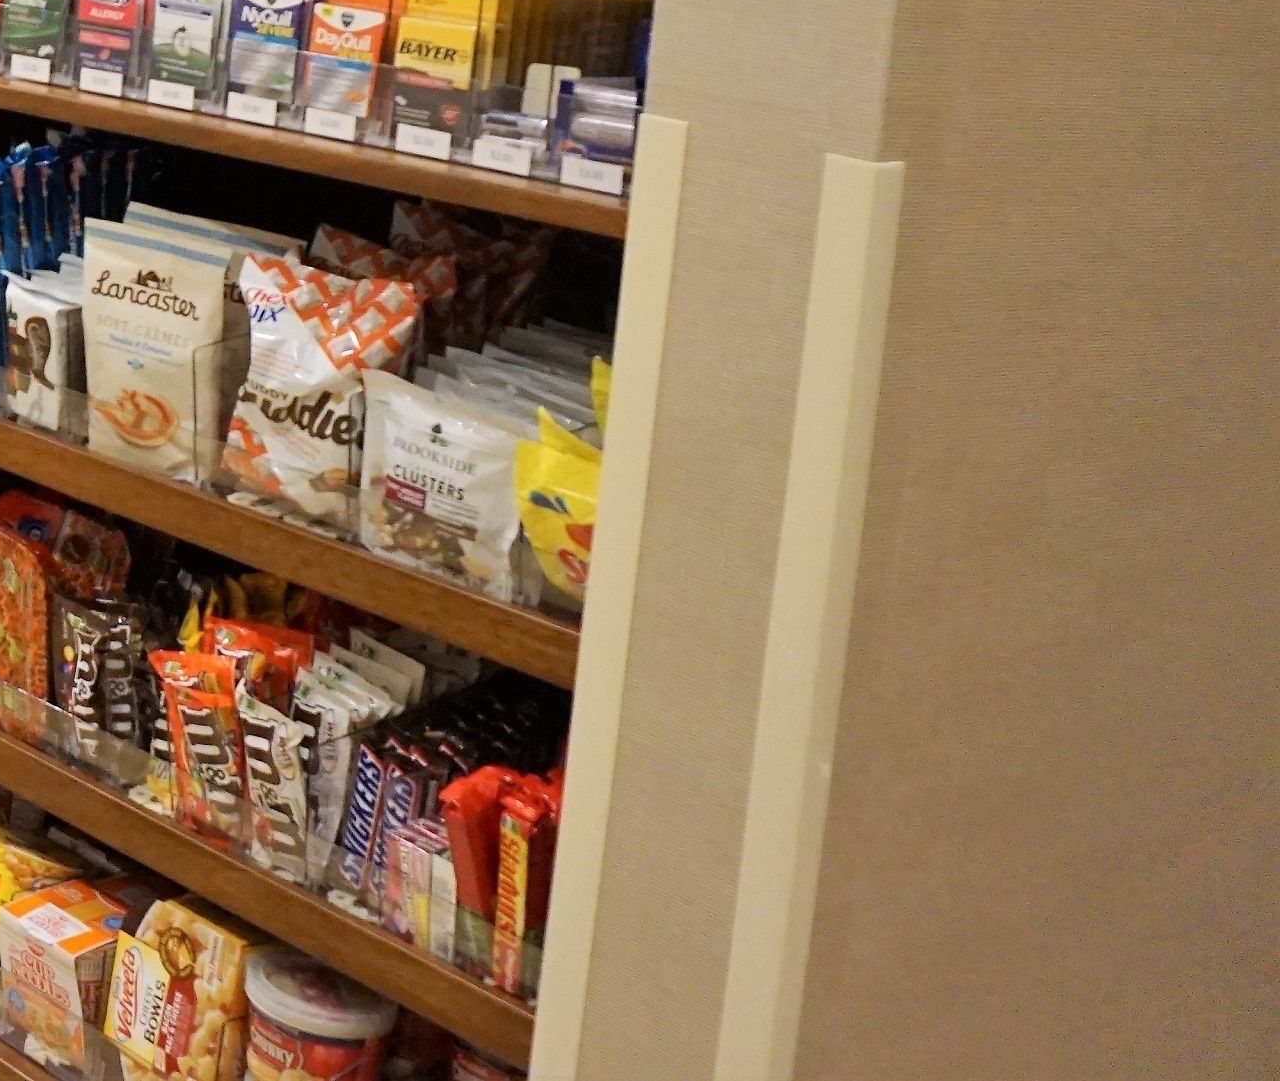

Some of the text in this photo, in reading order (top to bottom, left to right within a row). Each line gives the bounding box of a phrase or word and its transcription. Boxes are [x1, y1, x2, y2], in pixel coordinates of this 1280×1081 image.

[398, 38, 458, 62] BAYER
[91, 269, 200, 322] Lancaster
[392, 463, 466, 502] CLUSTERS
[115, 949, 137, 1040] Velveeta
[143, 980, 166, 1044] BOWLS
